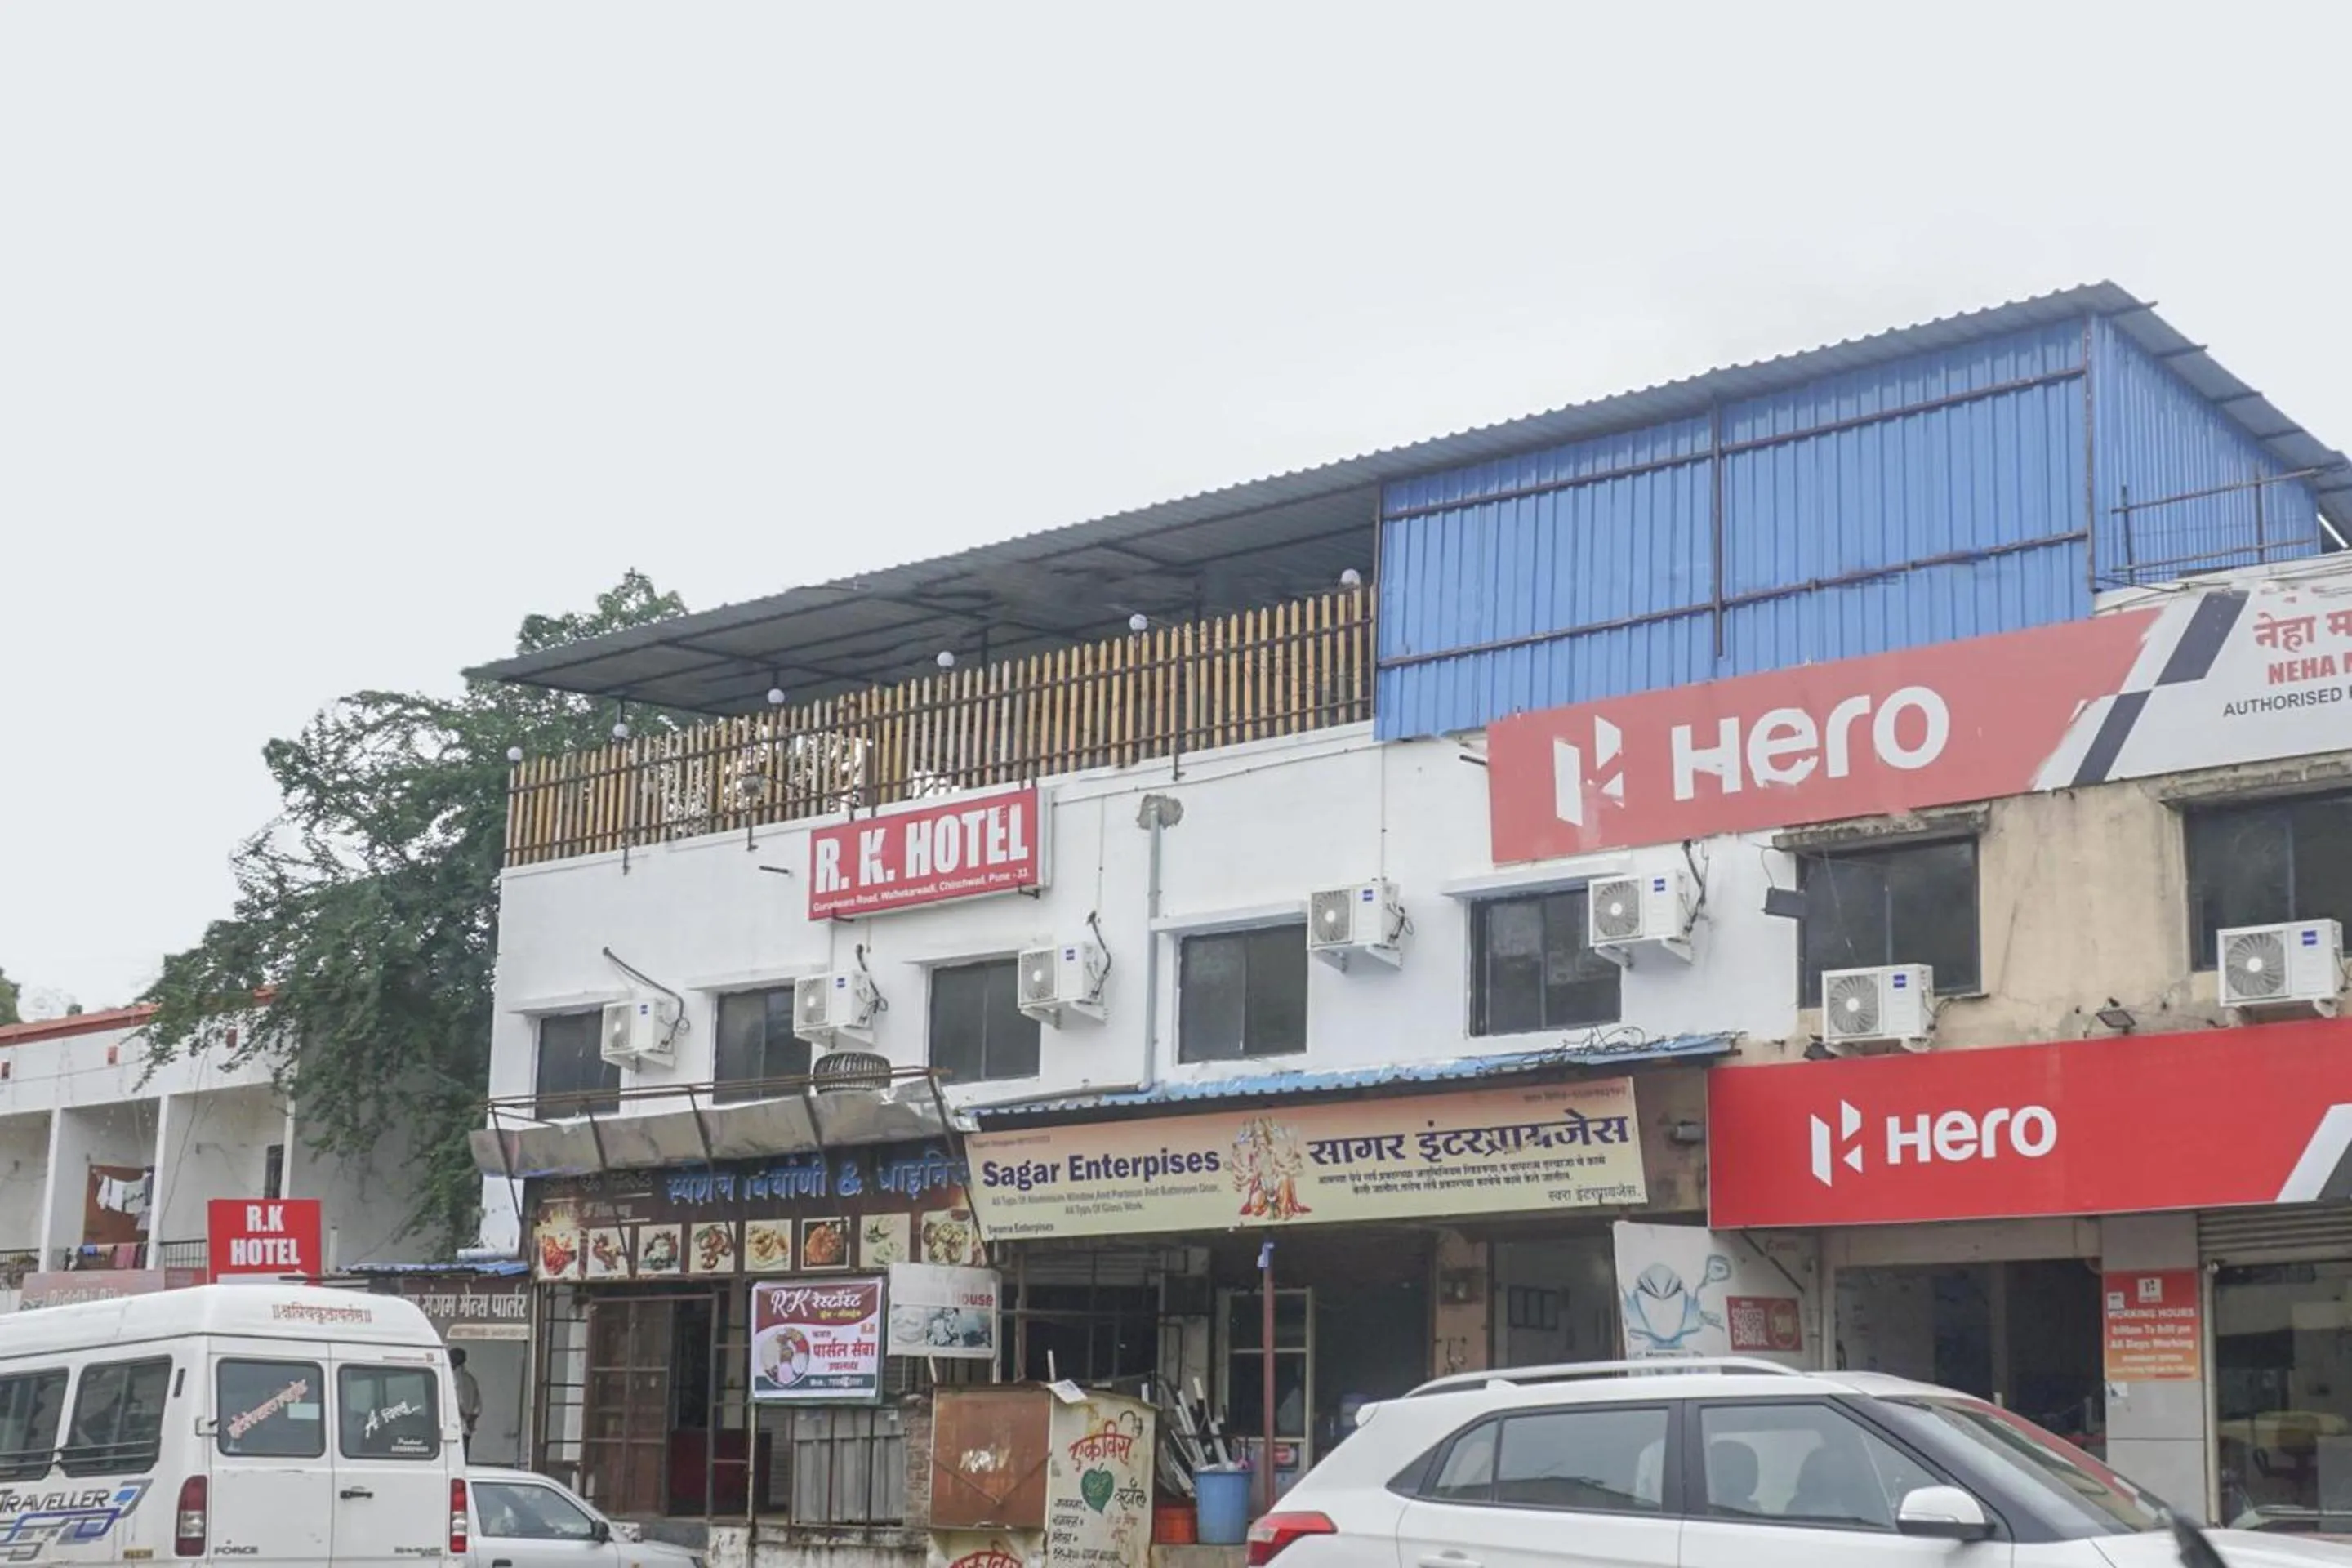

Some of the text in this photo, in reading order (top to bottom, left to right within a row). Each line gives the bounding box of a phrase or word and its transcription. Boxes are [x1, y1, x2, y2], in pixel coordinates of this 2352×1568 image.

[2252, 612, 2317, 653] नेहा
[2268, 654, 2336, 686] NEHA
[2223, 687, 2342, 717] AUTHORISED
[1671, 686, 1950, 802] Hero
[906, 803, 1028, 878] HOTEL
[1307, 1134, 1405, 1165] सागर
[1886, 1104, 2057, 1165] Hero
[982, 1147, 1221, 1191] Sagar Enterpises
[247, 1204, 284, 1232] R.K
[229, 1236, 301, 1267] HOTEL
[954, 1293, 994, 1307] ouse
